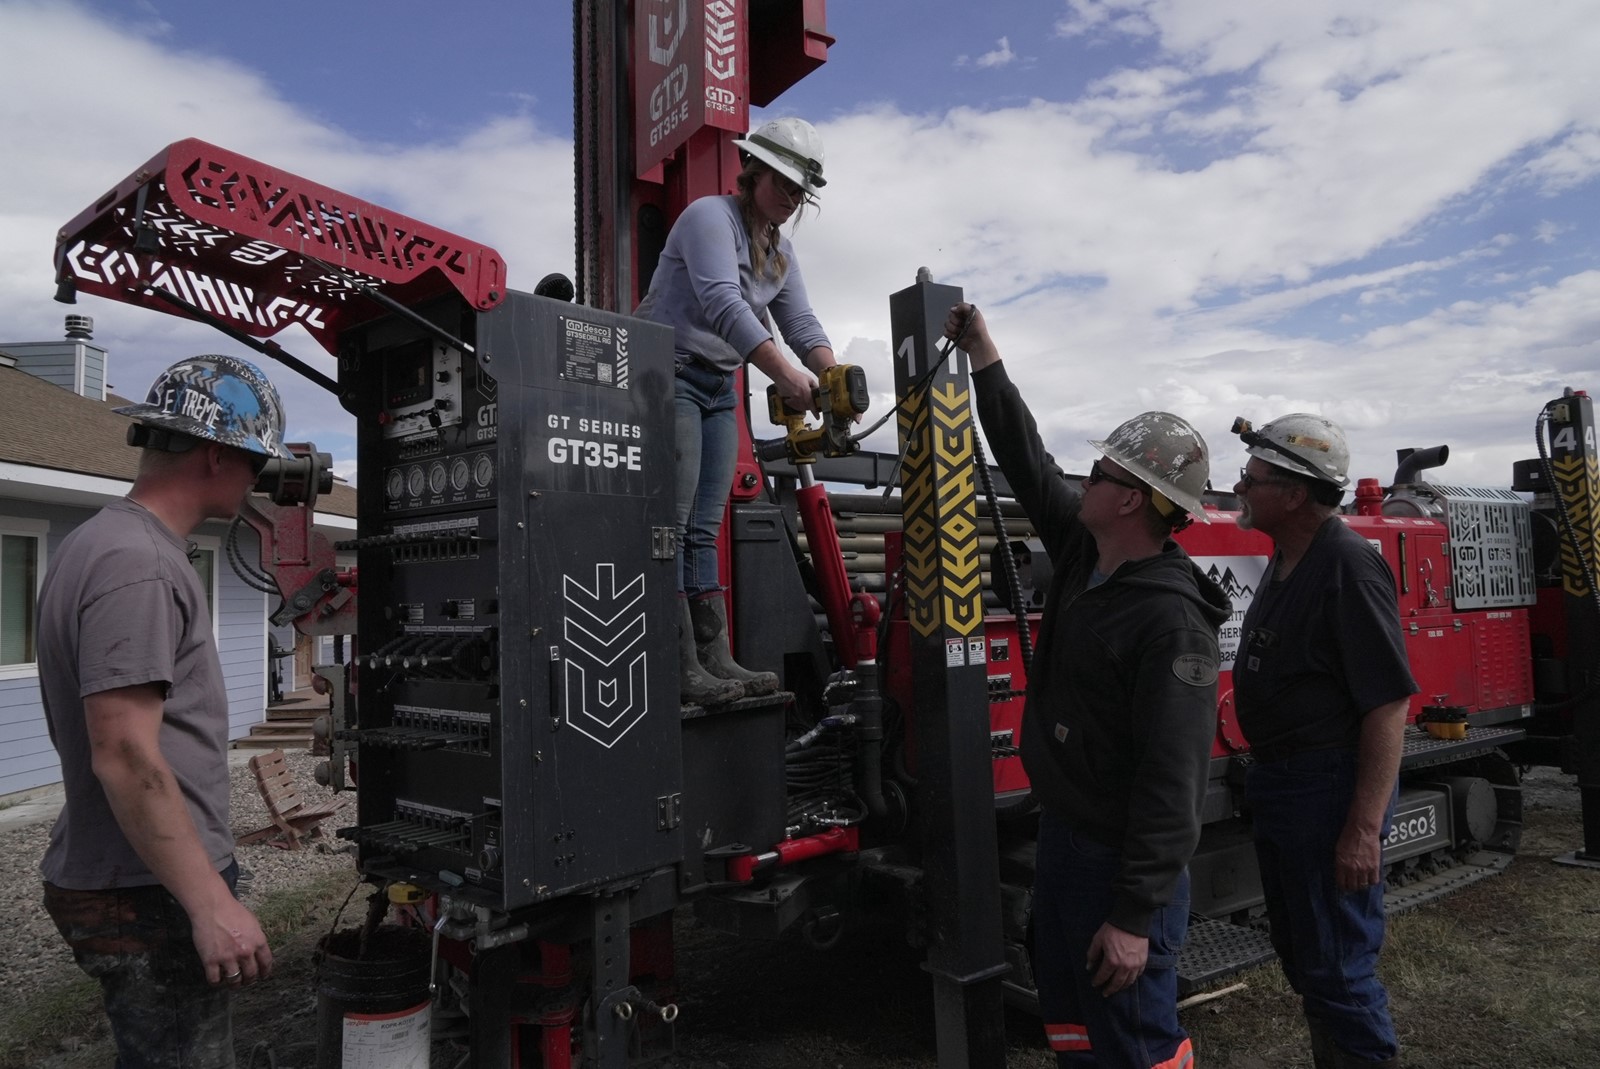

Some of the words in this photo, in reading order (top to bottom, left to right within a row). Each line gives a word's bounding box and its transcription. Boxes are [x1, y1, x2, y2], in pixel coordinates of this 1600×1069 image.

[650, 63, 688, 122] GTD
[705, 86, 735, 105] GTD
[705, 101, 735, 114] GT35-E
[650, 100, 688, 147] GT35-E
[583, 324, 608, 336] desco
[897, 335, 916, 378] 1
[935, 335, 958, 375] 1
[161, 388, 224, 430] EXTREME
[477, 403, 496, 426] GT
[547, 414, 570, 430] GT
[579, 418, 642, 438] SERIES
[1585, 426, 1595, 450] 4
[1554, 426, 1577, 451] 4
[547, 437, 642, 471] GT35-E
[1459, 546, 1476, 561] GTD
[1488, 548, 1512, 561] GT35
[1383, 816, 1428, 846] esco
